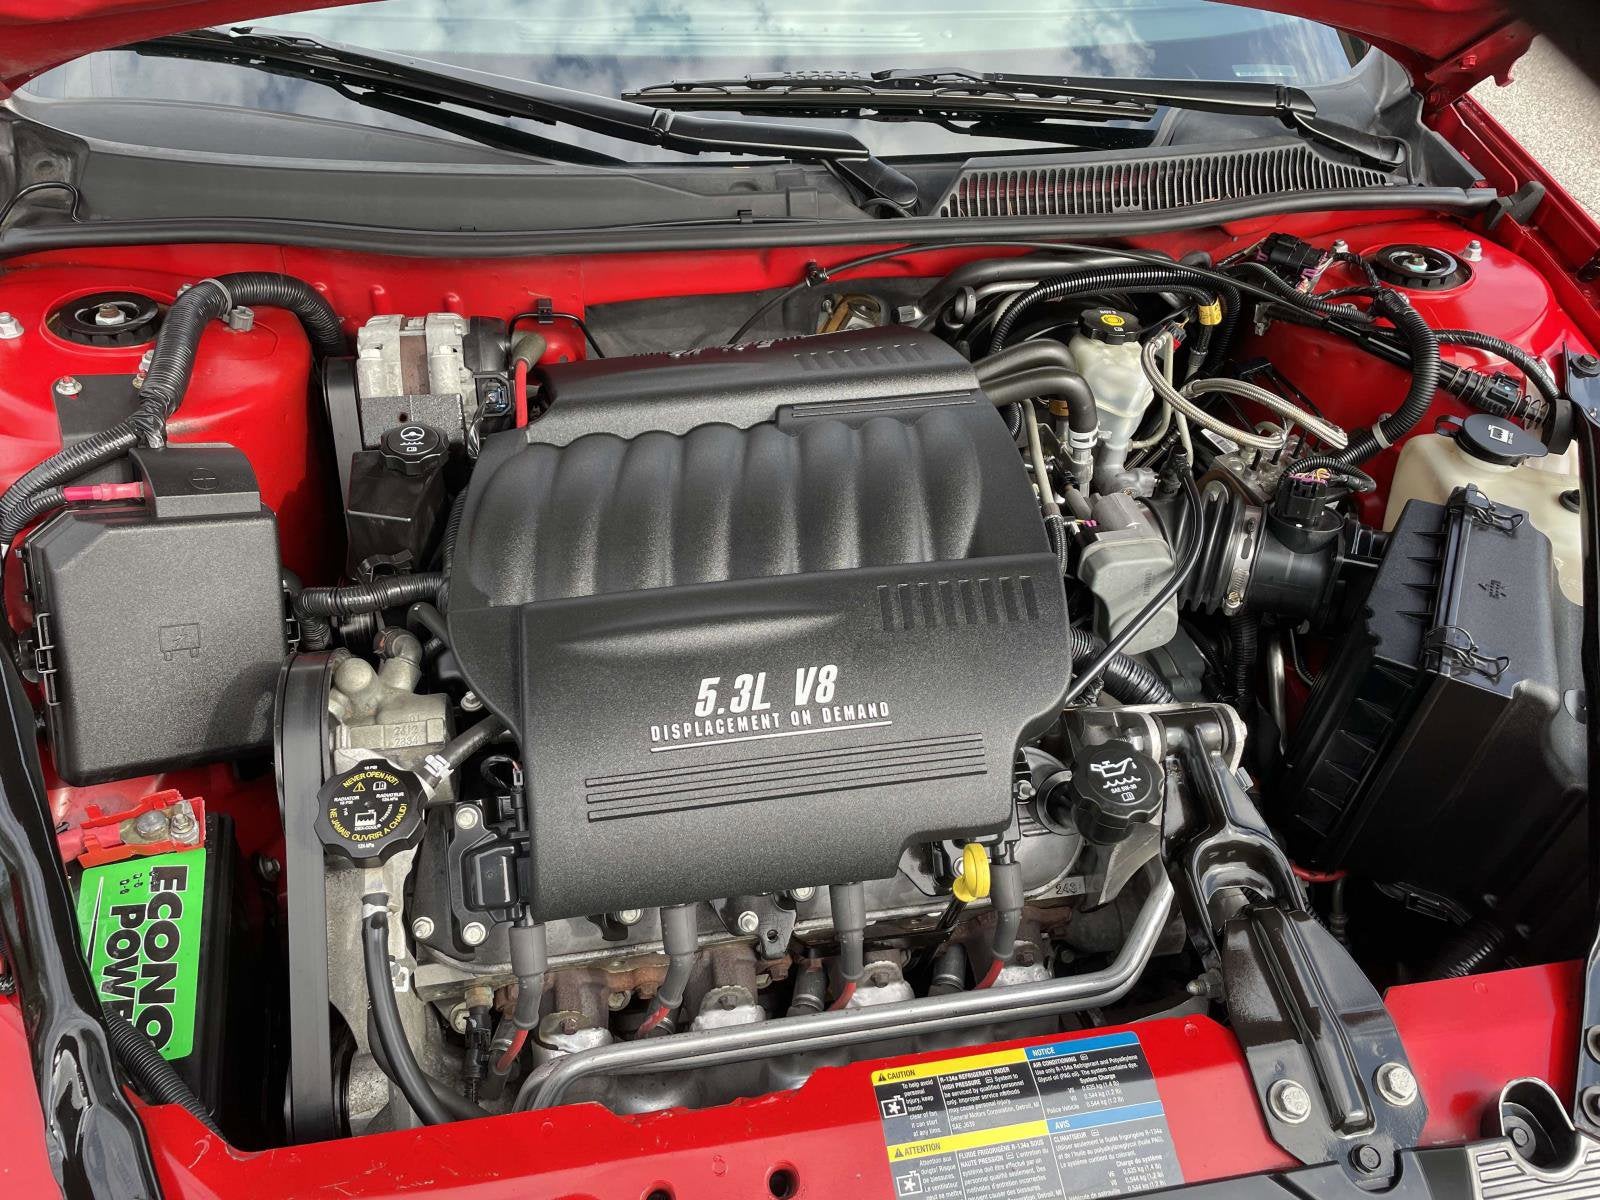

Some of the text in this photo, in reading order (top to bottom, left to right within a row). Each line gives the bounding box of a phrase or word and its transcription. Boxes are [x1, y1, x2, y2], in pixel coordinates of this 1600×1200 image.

[694, 664, 838, 717] 5.3L V8
[650, 701, 890, 742] DISPLACEMENT ON DEMAND
[342, 771, 400, 788] NEVER OPEN HOT!
[1110, 785, 1122, 794] SAE
[329, 808, 338, 818] NE
[388, 803, 408, 829] CHAUD!
[331, 817, 351, 838] JAMAIS
[351, 831, 384, 841] OUVRIR
[133, 864, 189, 1052] ECONO
[1032, 1047, 1055, 1056] NOTICE
[1073, 1060, 1099, 1069] Refrigerant
[1090, 1066, 1107, 1074] system
[1107, 1063, 1127, 1071] contains
[887, 1069, 915, 1079] CAUTION
[939, 1066, 1009, 1083] R-134a REFRIGERANT UNDER
[1079, 1072, 1115, 1083] System Charge
[951, 1088, 972, 1097] serviced
[1000, 1079, 1024, 1089] personnel
[955, 1078, 980, 1088] PRESSURE
[981, 1091, 998, 1100] service
[975, 1101, 996, 1109] personal
[950, 1113, 968, 1121] General
[968, 1110, 986, 1118] Motors
[1054, 1120, 1070, 1129] AVIS
[904, 1142, 940, 1155] ATTENTION
[978, 1154, 1003, 1164] PRESSION
